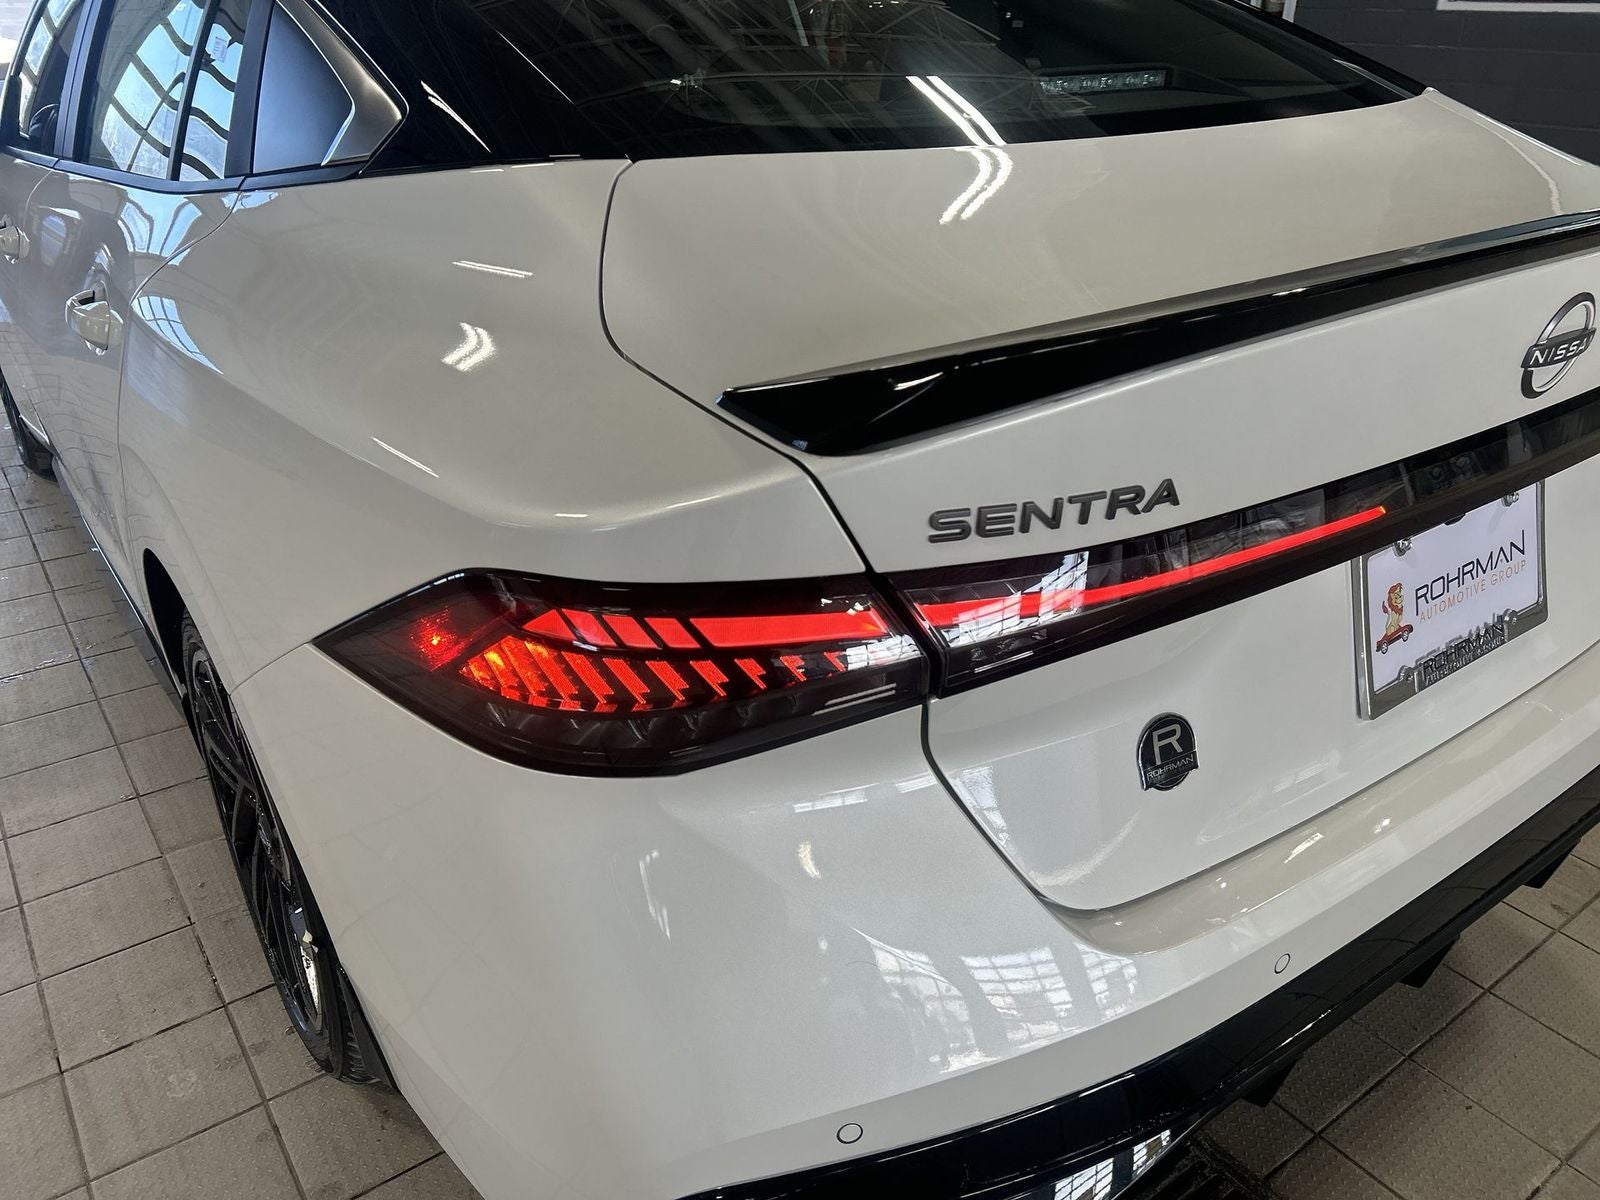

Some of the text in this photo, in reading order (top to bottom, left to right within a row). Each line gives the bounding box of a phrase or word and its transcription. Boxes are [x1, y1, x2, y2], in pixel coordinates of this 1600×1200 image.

[928, 478, 1180, 543] SENTRA
[1415, 529, 1525, 616] ROHRMAN
[1419, 559, 1527, 623] AUTOMOTIVE GROUP
[1422, 622, 1505, 684] ROHRMAN
[1146, 753, 1194, 781] ROHRMAN
[1152, 723, 1183, 765] R
